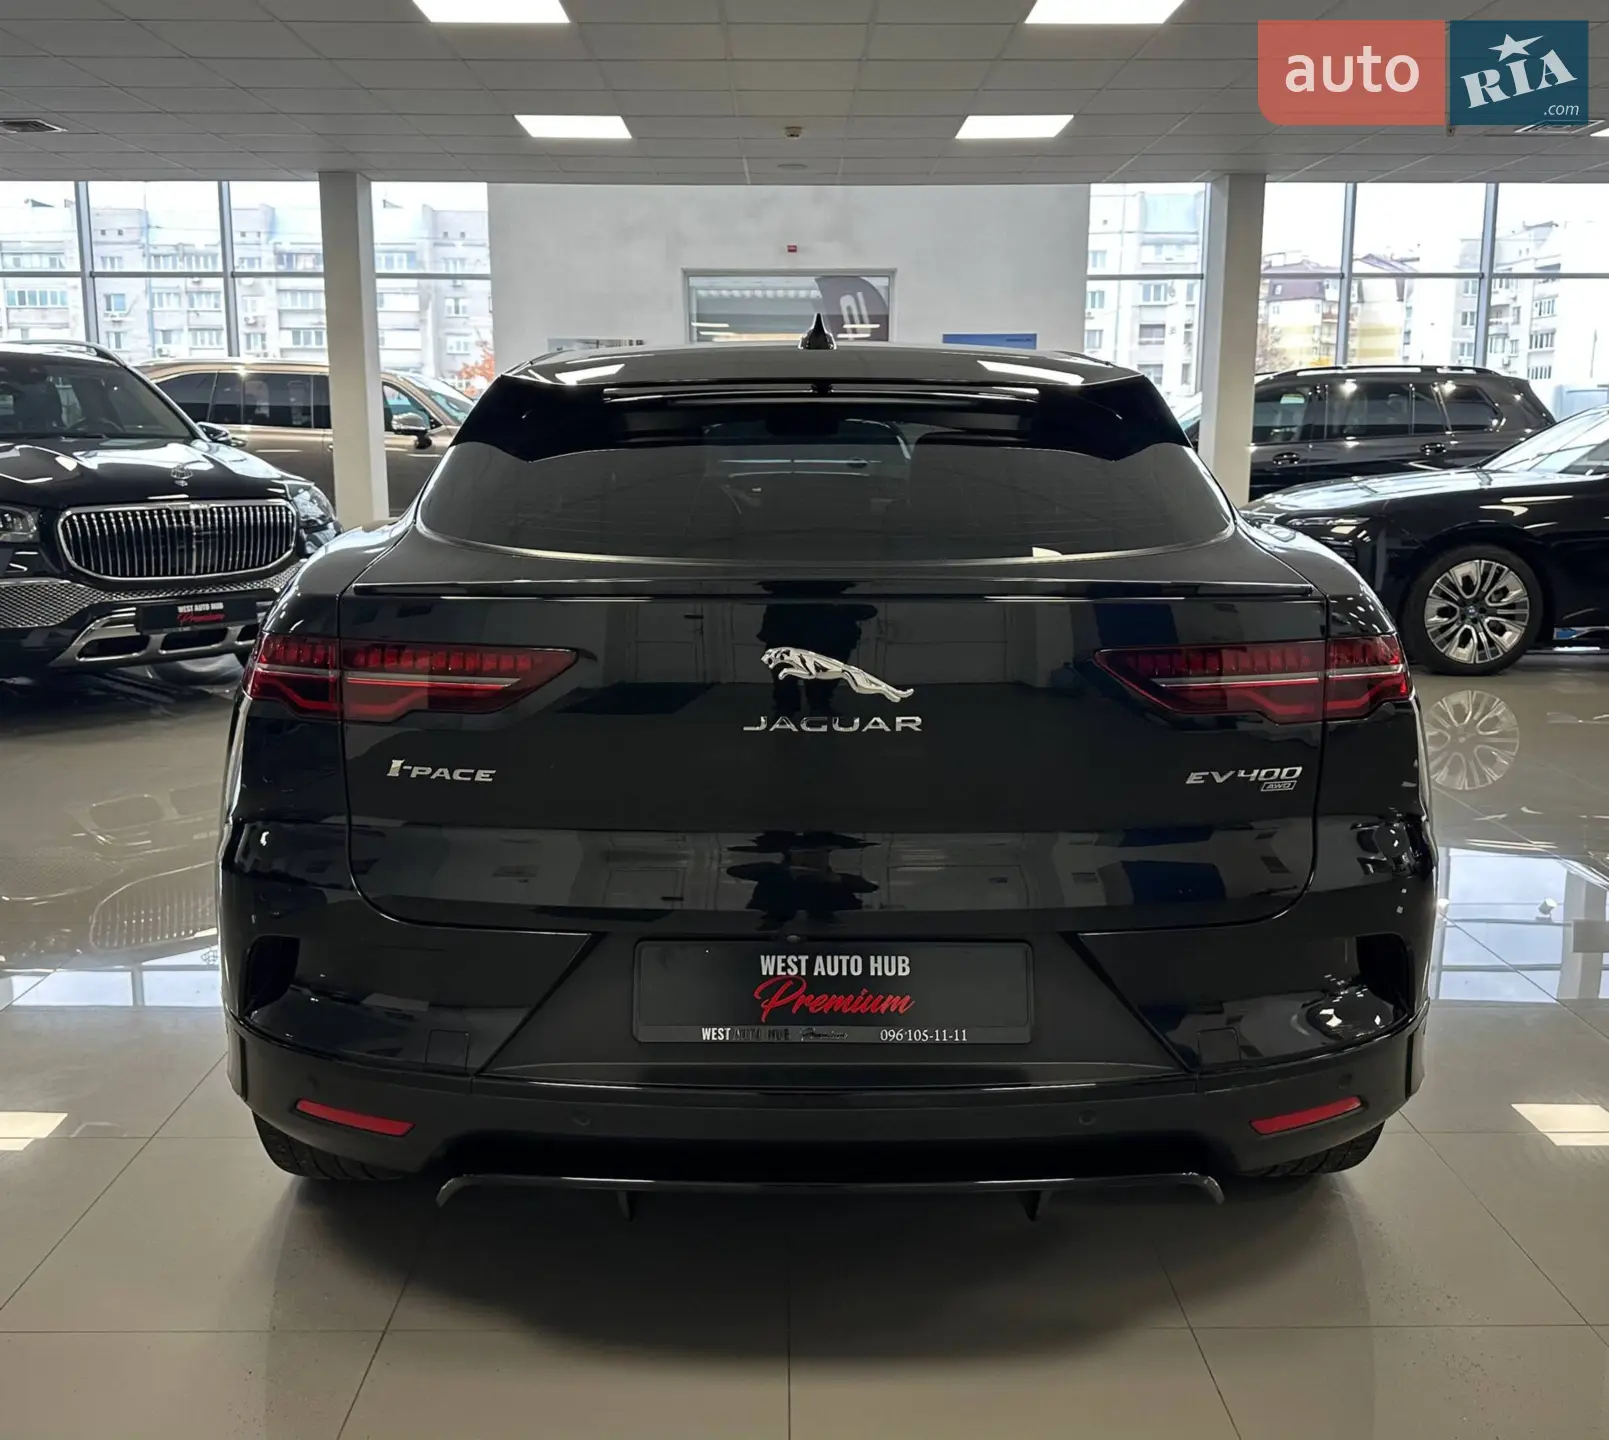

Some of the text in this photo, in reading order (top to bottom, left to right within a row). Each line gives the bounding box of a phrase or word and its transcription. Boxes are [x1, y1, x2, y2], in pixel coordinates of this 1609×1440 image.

[743, 716, 923, 732] JAGUAR
[386, 759, 497, 782] I-PACE
[1186, 766, 1303, 784] EV400
[1264, 782, 1293, 790] AWD
[760, 955, 911, 976] WEST AUTO HUB
[753, 975, 915, 1023] Premium
[701, 1027, 731, 1041] WEST
[880, 1029, 904, 1042] 096
